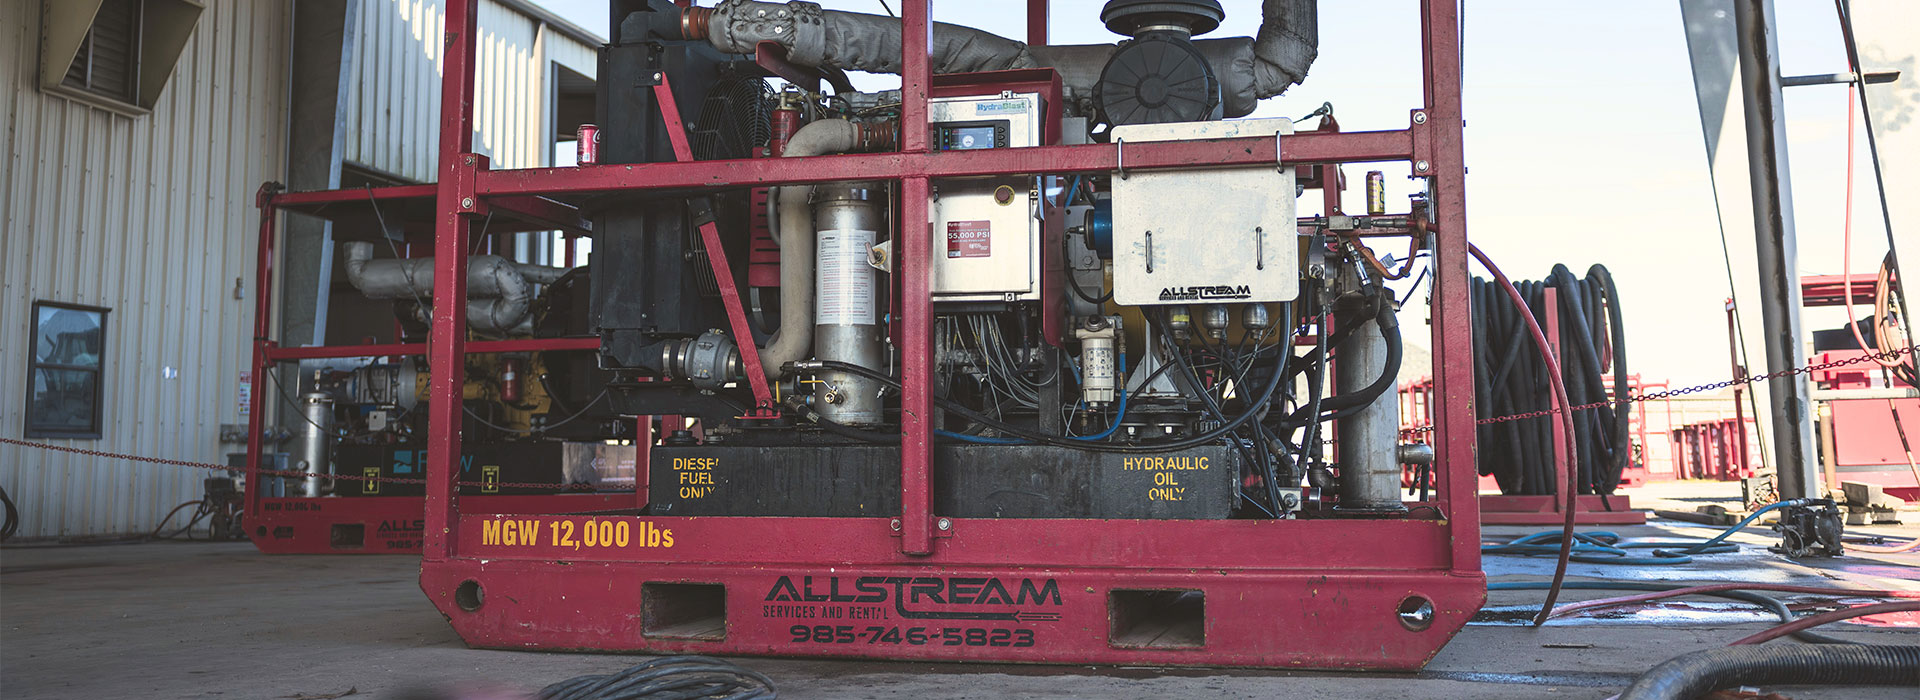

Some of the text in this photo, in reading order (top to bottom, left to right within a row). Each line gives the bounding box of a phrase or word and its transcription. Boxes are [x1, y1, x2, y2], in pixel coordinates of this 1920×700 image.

[977, 102, 1026, 111] HydraBlast
[948, 231, 975, 239] 55,000
[1159, 285, 1251, 297] ALLSTREAM
[1123, 457, 1209, 470] HYDRAULIC
[680, 472, 715, 484] FUEL
[1154, 472, 1178, 485] OIL
[1148, 488, 1185, 500] ONLY
[482, 520, 675, 551] MGW 12,000 lbs
[763, 576, 1063, 613] ALLSTREAM
[763, 605, 816, 619] SERVICES
[822, 606, 842, 619] AND
[790, 625, 1036, 647] 985-746-5823
